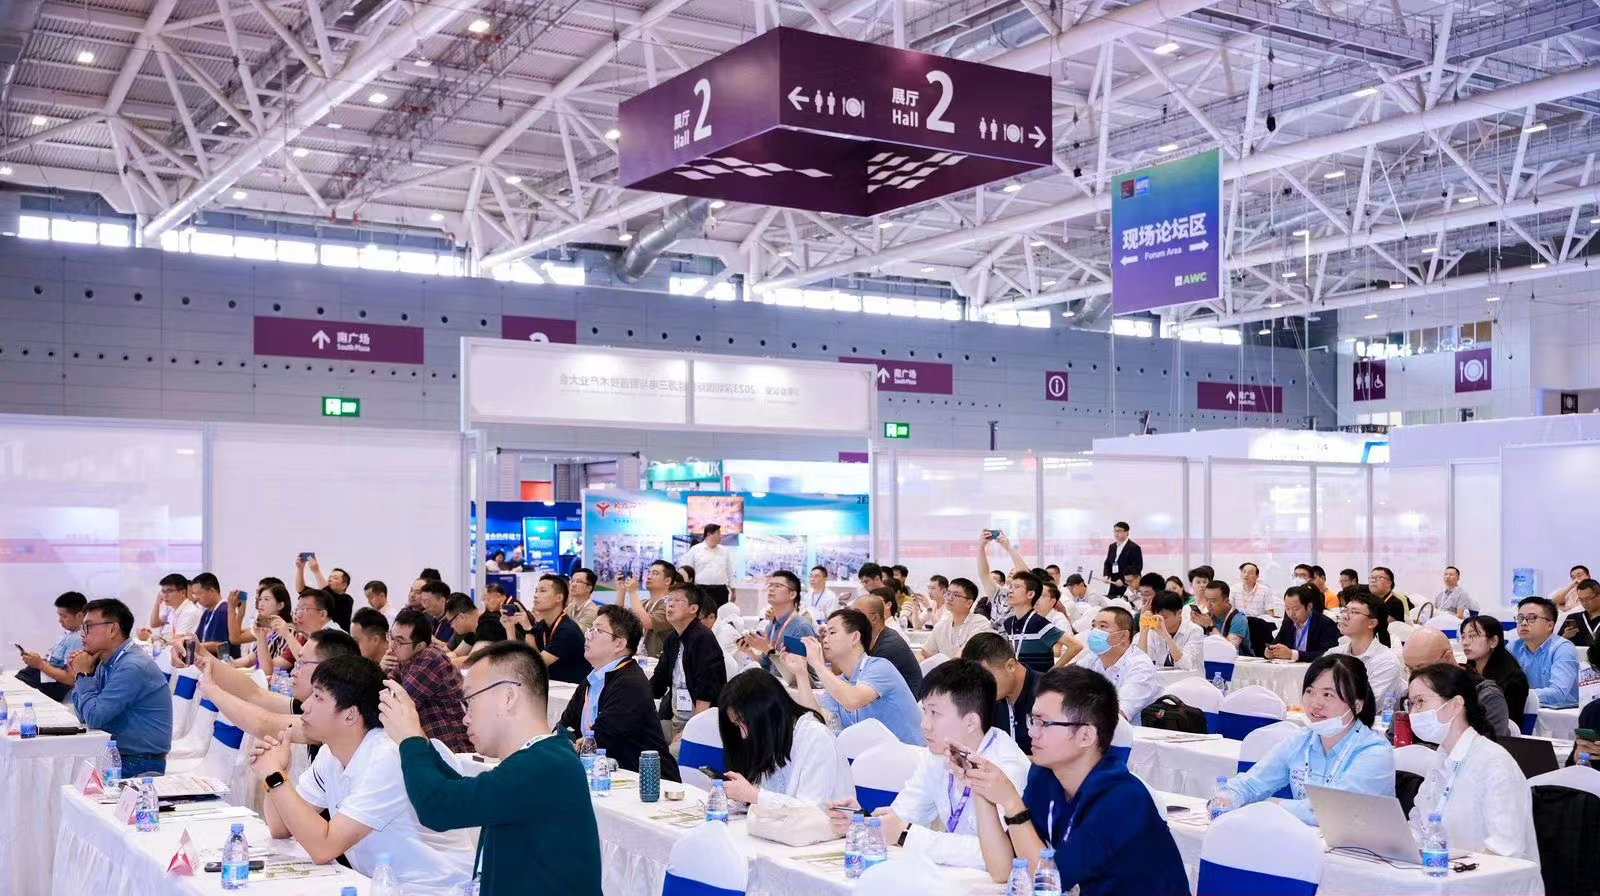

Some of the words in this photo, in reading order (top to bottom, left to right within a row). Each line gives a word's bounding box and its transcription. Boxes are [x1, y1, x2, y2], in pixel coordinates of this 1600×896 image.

[892, 87, 919, 107] 展厅
[926, 70, 955, 134] 2
[673, 109, 690, 130] 展厅
[694, 78, 711, 142] 2
[892, 108, 919, 128] Hall
[673, 129, 690, 150] Hall
[1122, 213, 1207, 250] 现场论坛区
[1144, 250, 1166, 261] Forum
[1166, 247, 1182, 256] Area
[1183, 271, 1207, 285] AWC
[337, 331, 370, 345] 南广场
